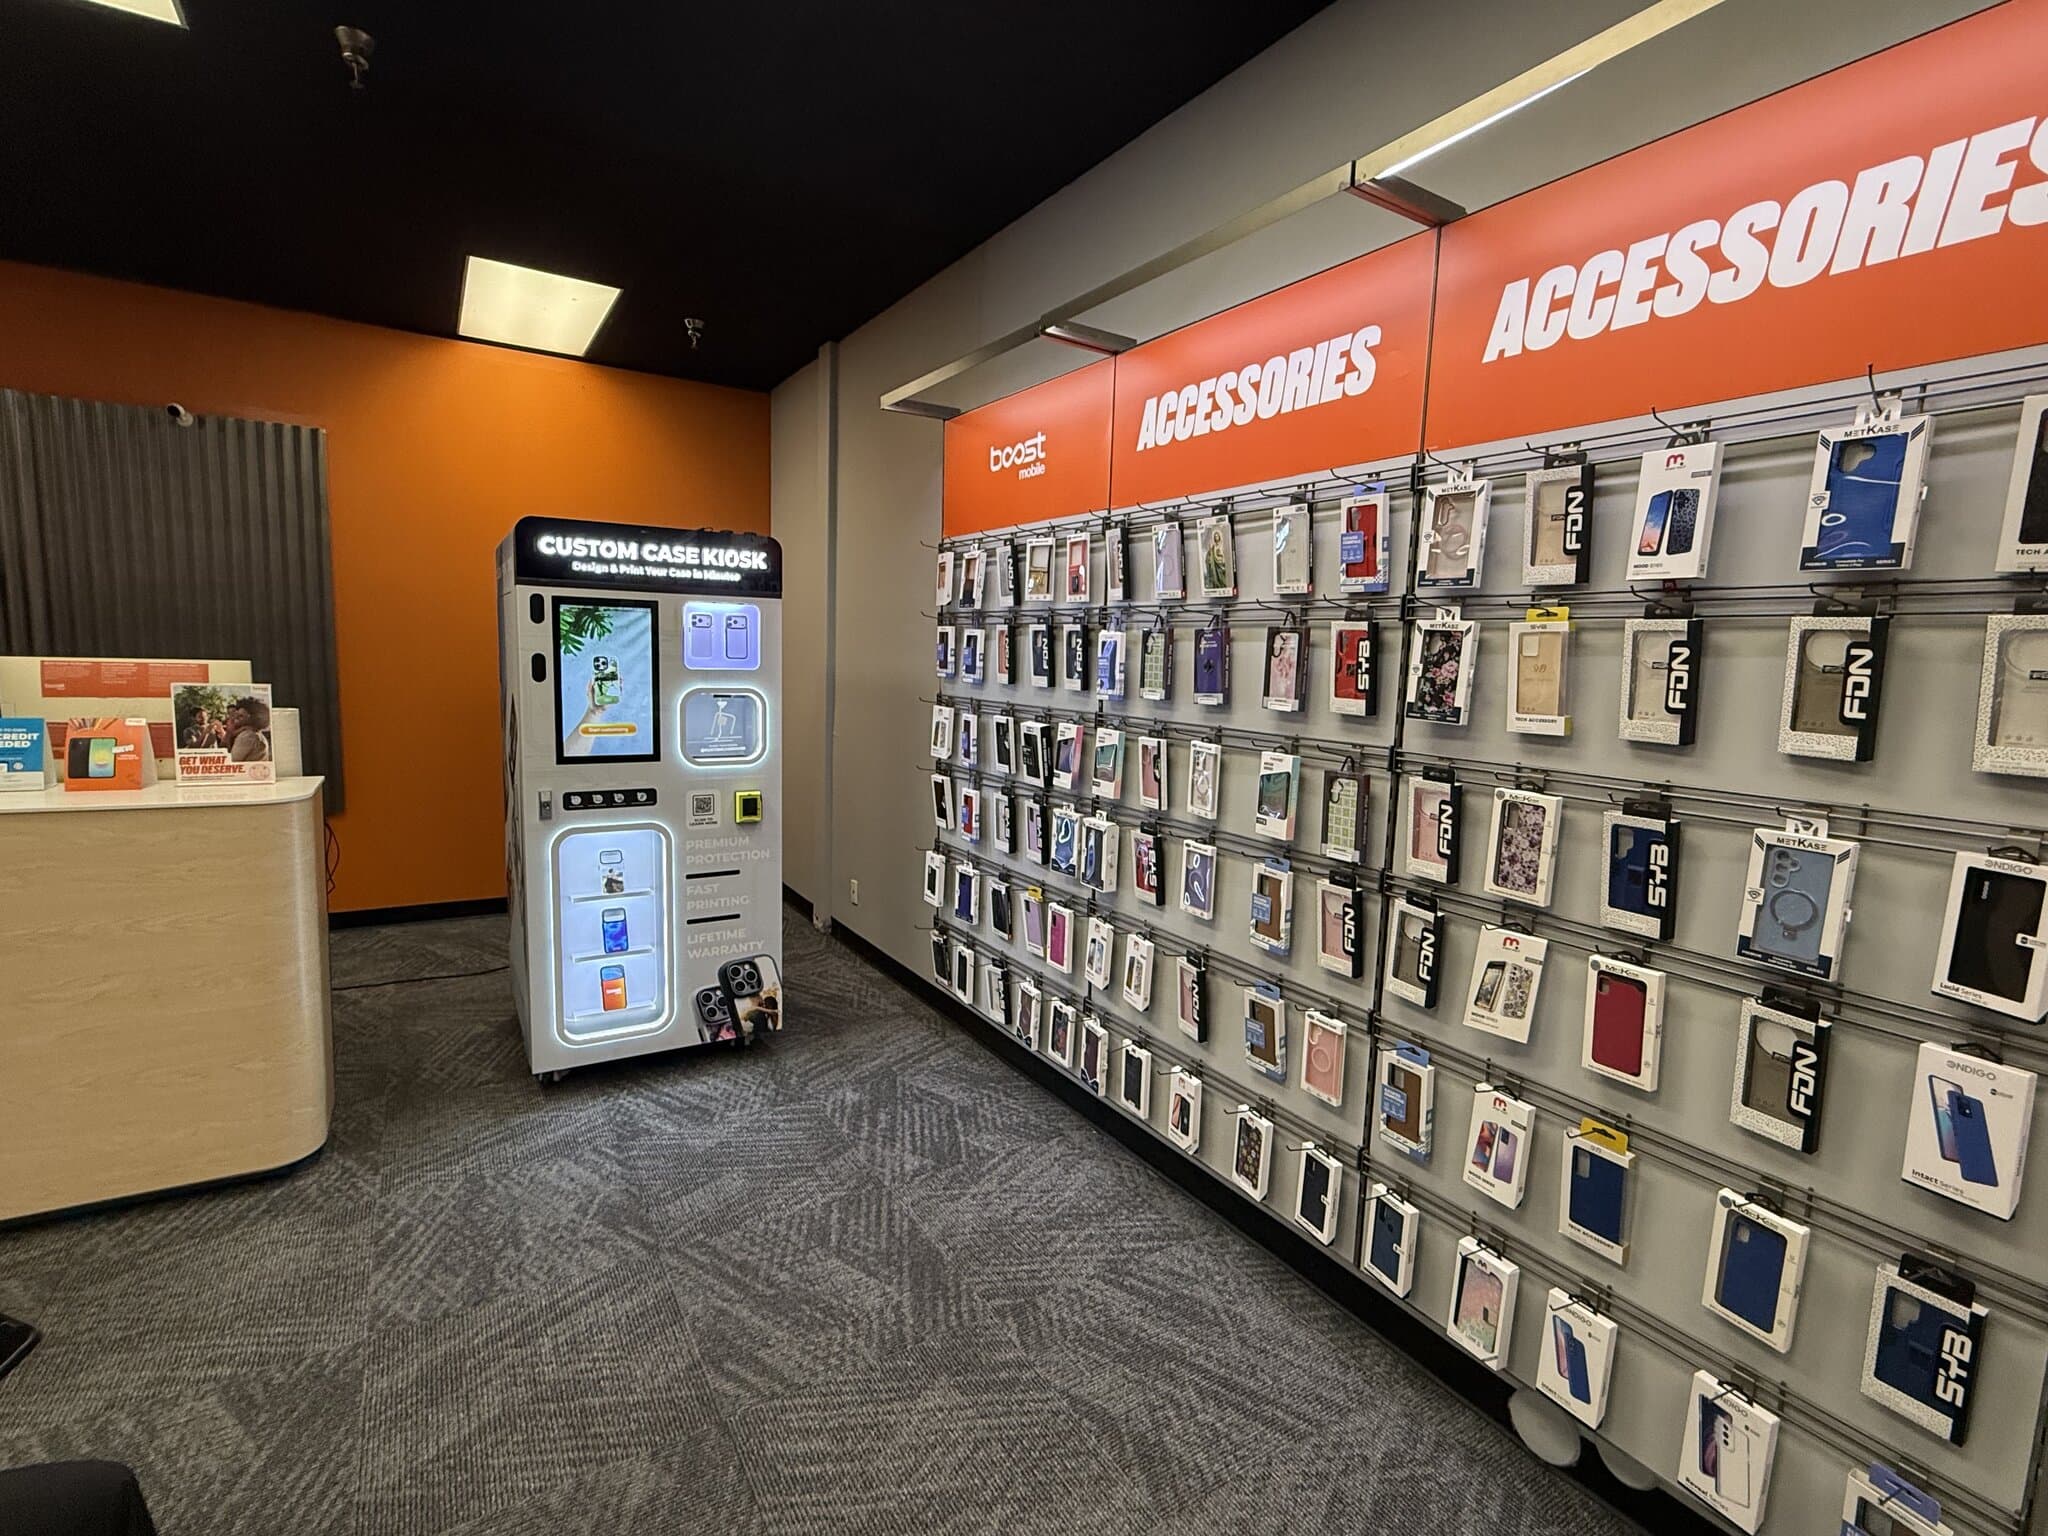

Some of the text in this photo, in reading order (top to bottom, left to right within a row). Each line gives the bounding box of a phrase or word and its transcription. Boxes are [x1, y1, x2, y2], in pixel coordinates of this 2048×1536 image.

[1136, 324, 1382, 452] ACCESSORIES
[1844, 424, 1900, 438] METKASE
[989, 432, 1047, 473] boost
[1018, 460, 1047, 481] mobile
[1565, 491, 1584, 551] FDN
[537, 535, 768, 570] CUSTOM CASE KIOSK
[2016, 548, 2041, 556] TECH
[571, 561, 609, 574] Design
[610, 564, 619, 574] &
[619, 564, 645, 575] Print
[645, 566, 668, 577] Your
[669, 568, 692, 578] Case
[692, 569, 704, 579] in
[1357, 639, 1371, 691] SYB
[1669, 646, 1691, 710] FDN
[1843, 648, 1874, 721] FDN
[179, 756, 227, 765] GET WHAT
[180, 764, 246, 775] YOU DESERVE.
[1439, 803, 1453, 855] FDN
[686, 836, 750, 850] PREMIUM
[1776, 837, 1828, 851] METKASE
[686, 849, 771, 865] PROTECTION
[1648, 843, 1669, 908] SYB
[686, 884, 720, 896] FAST
[687, 895, 750, 911] PRINTING
[687, 928, 748, 946] LIFETIME
[1343, 906, 1356, 953] FDN
[687, 940, 765, 960] WARRANTY
[1419, 931, 1436, 982] FDN
[1940, 982, 1960, 993] Lucid
[1192, 980, 1200, 1022] FDN
[1791, 1046, 1818, 1117] FDN
[1912, 1169, 1939, 1185] Intact
[1935, 1329, 1973, 1408] SYB
